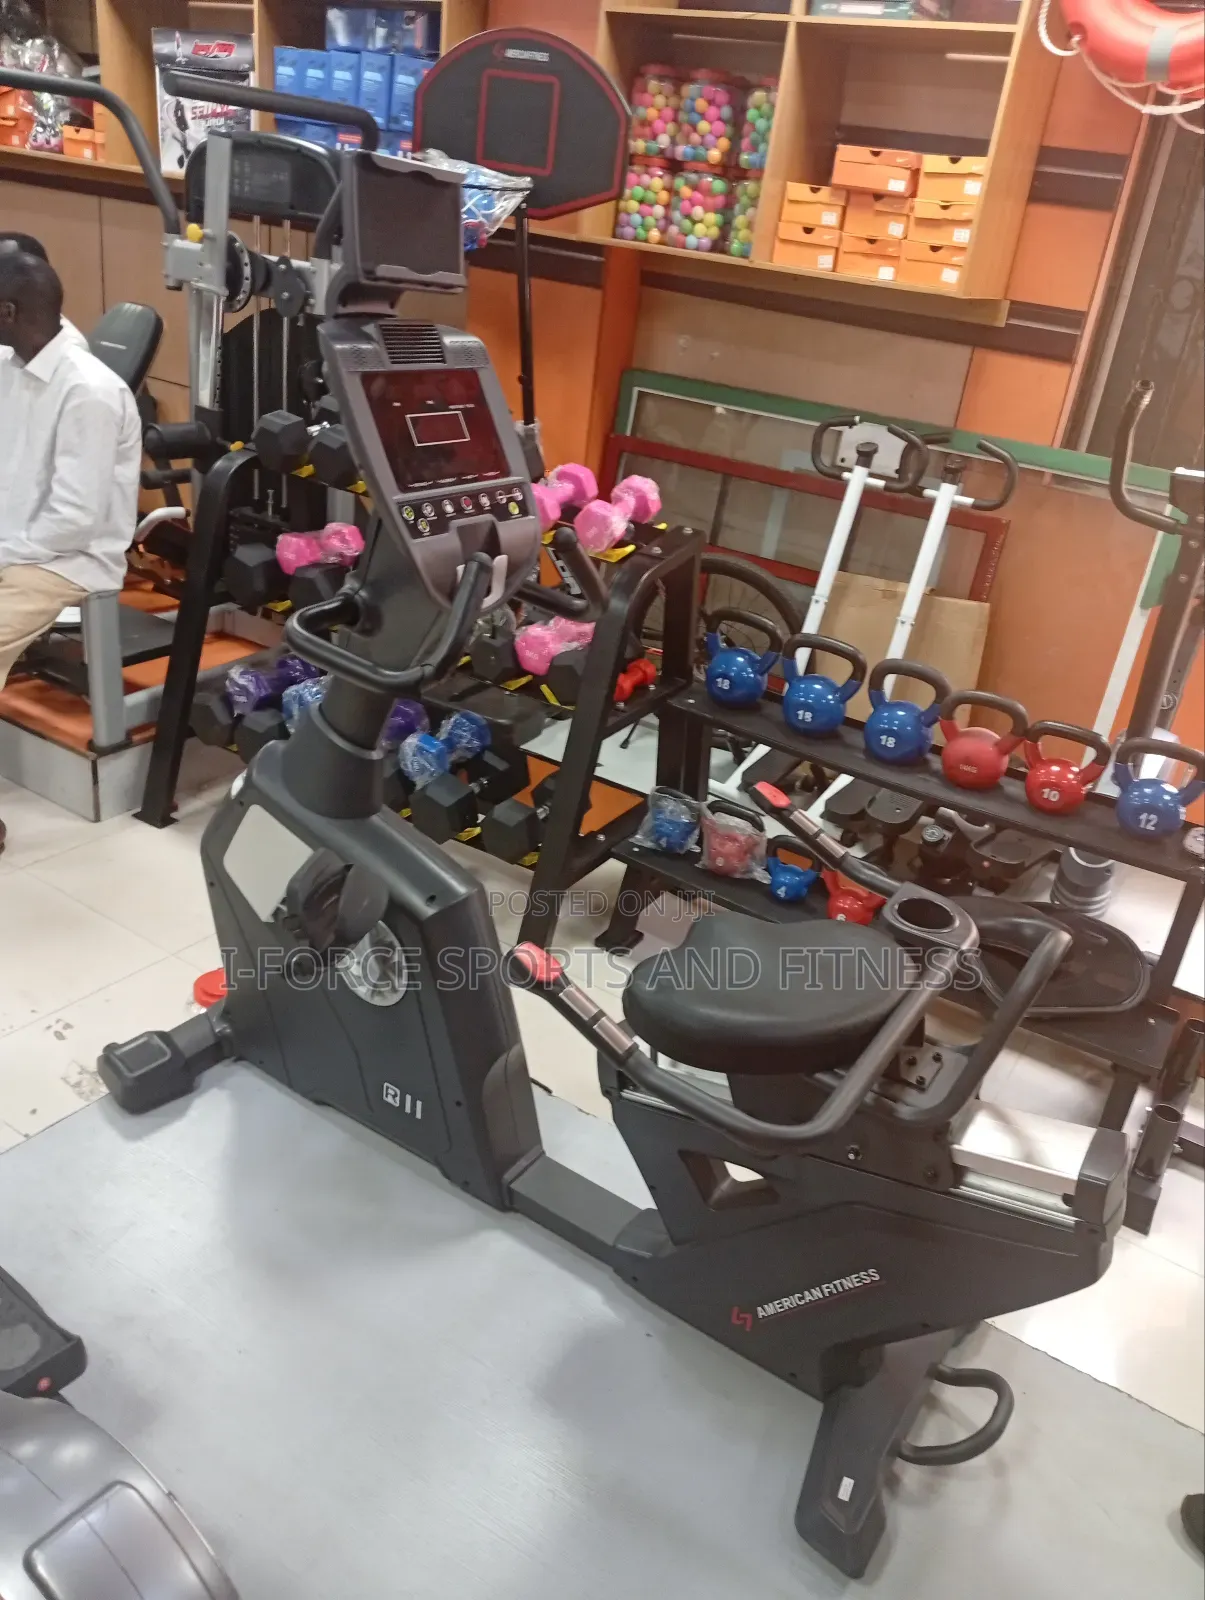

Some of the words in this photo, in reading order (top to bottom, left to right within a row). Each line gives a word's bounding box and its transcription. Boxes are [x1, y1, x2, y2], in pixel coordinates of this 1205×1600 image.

[716, 678, 730, 689] 18
[796, 710, 813, 722] 18
[880, 735, 896, 748] 18
[1042, 788, 1060, 802] 10
[1139, 812, 1158, 831] 12
[777, 886, 787, 899] 4
